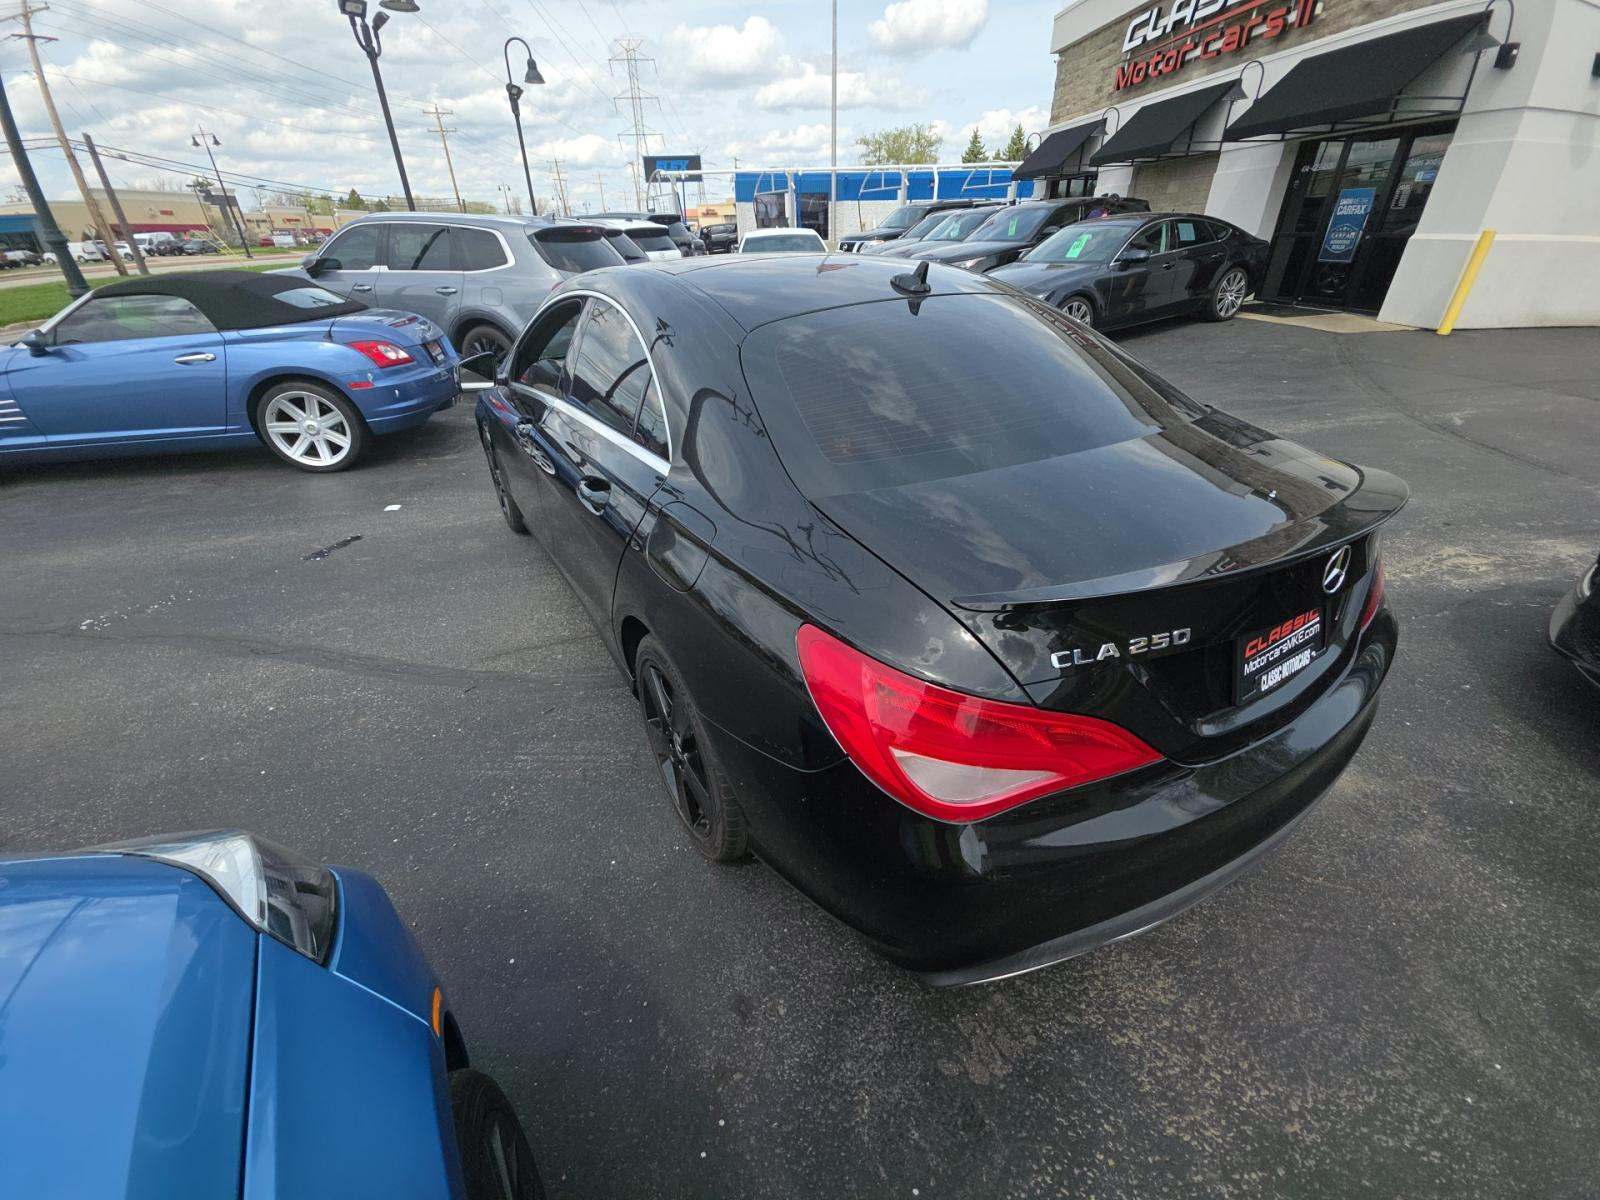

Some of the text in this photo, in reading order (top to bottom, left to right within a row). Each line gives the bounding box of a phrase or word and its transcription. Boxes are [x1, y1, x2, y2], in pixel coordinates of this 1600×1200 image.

[1336, 204, 1368, 216] CARFAX
[1050, 628, 1192, 669] CLA 250
[1244, 609, 1320, 659] CLASSIC
[1244, 623, 1320, 676] MotorcarsMKE.com
